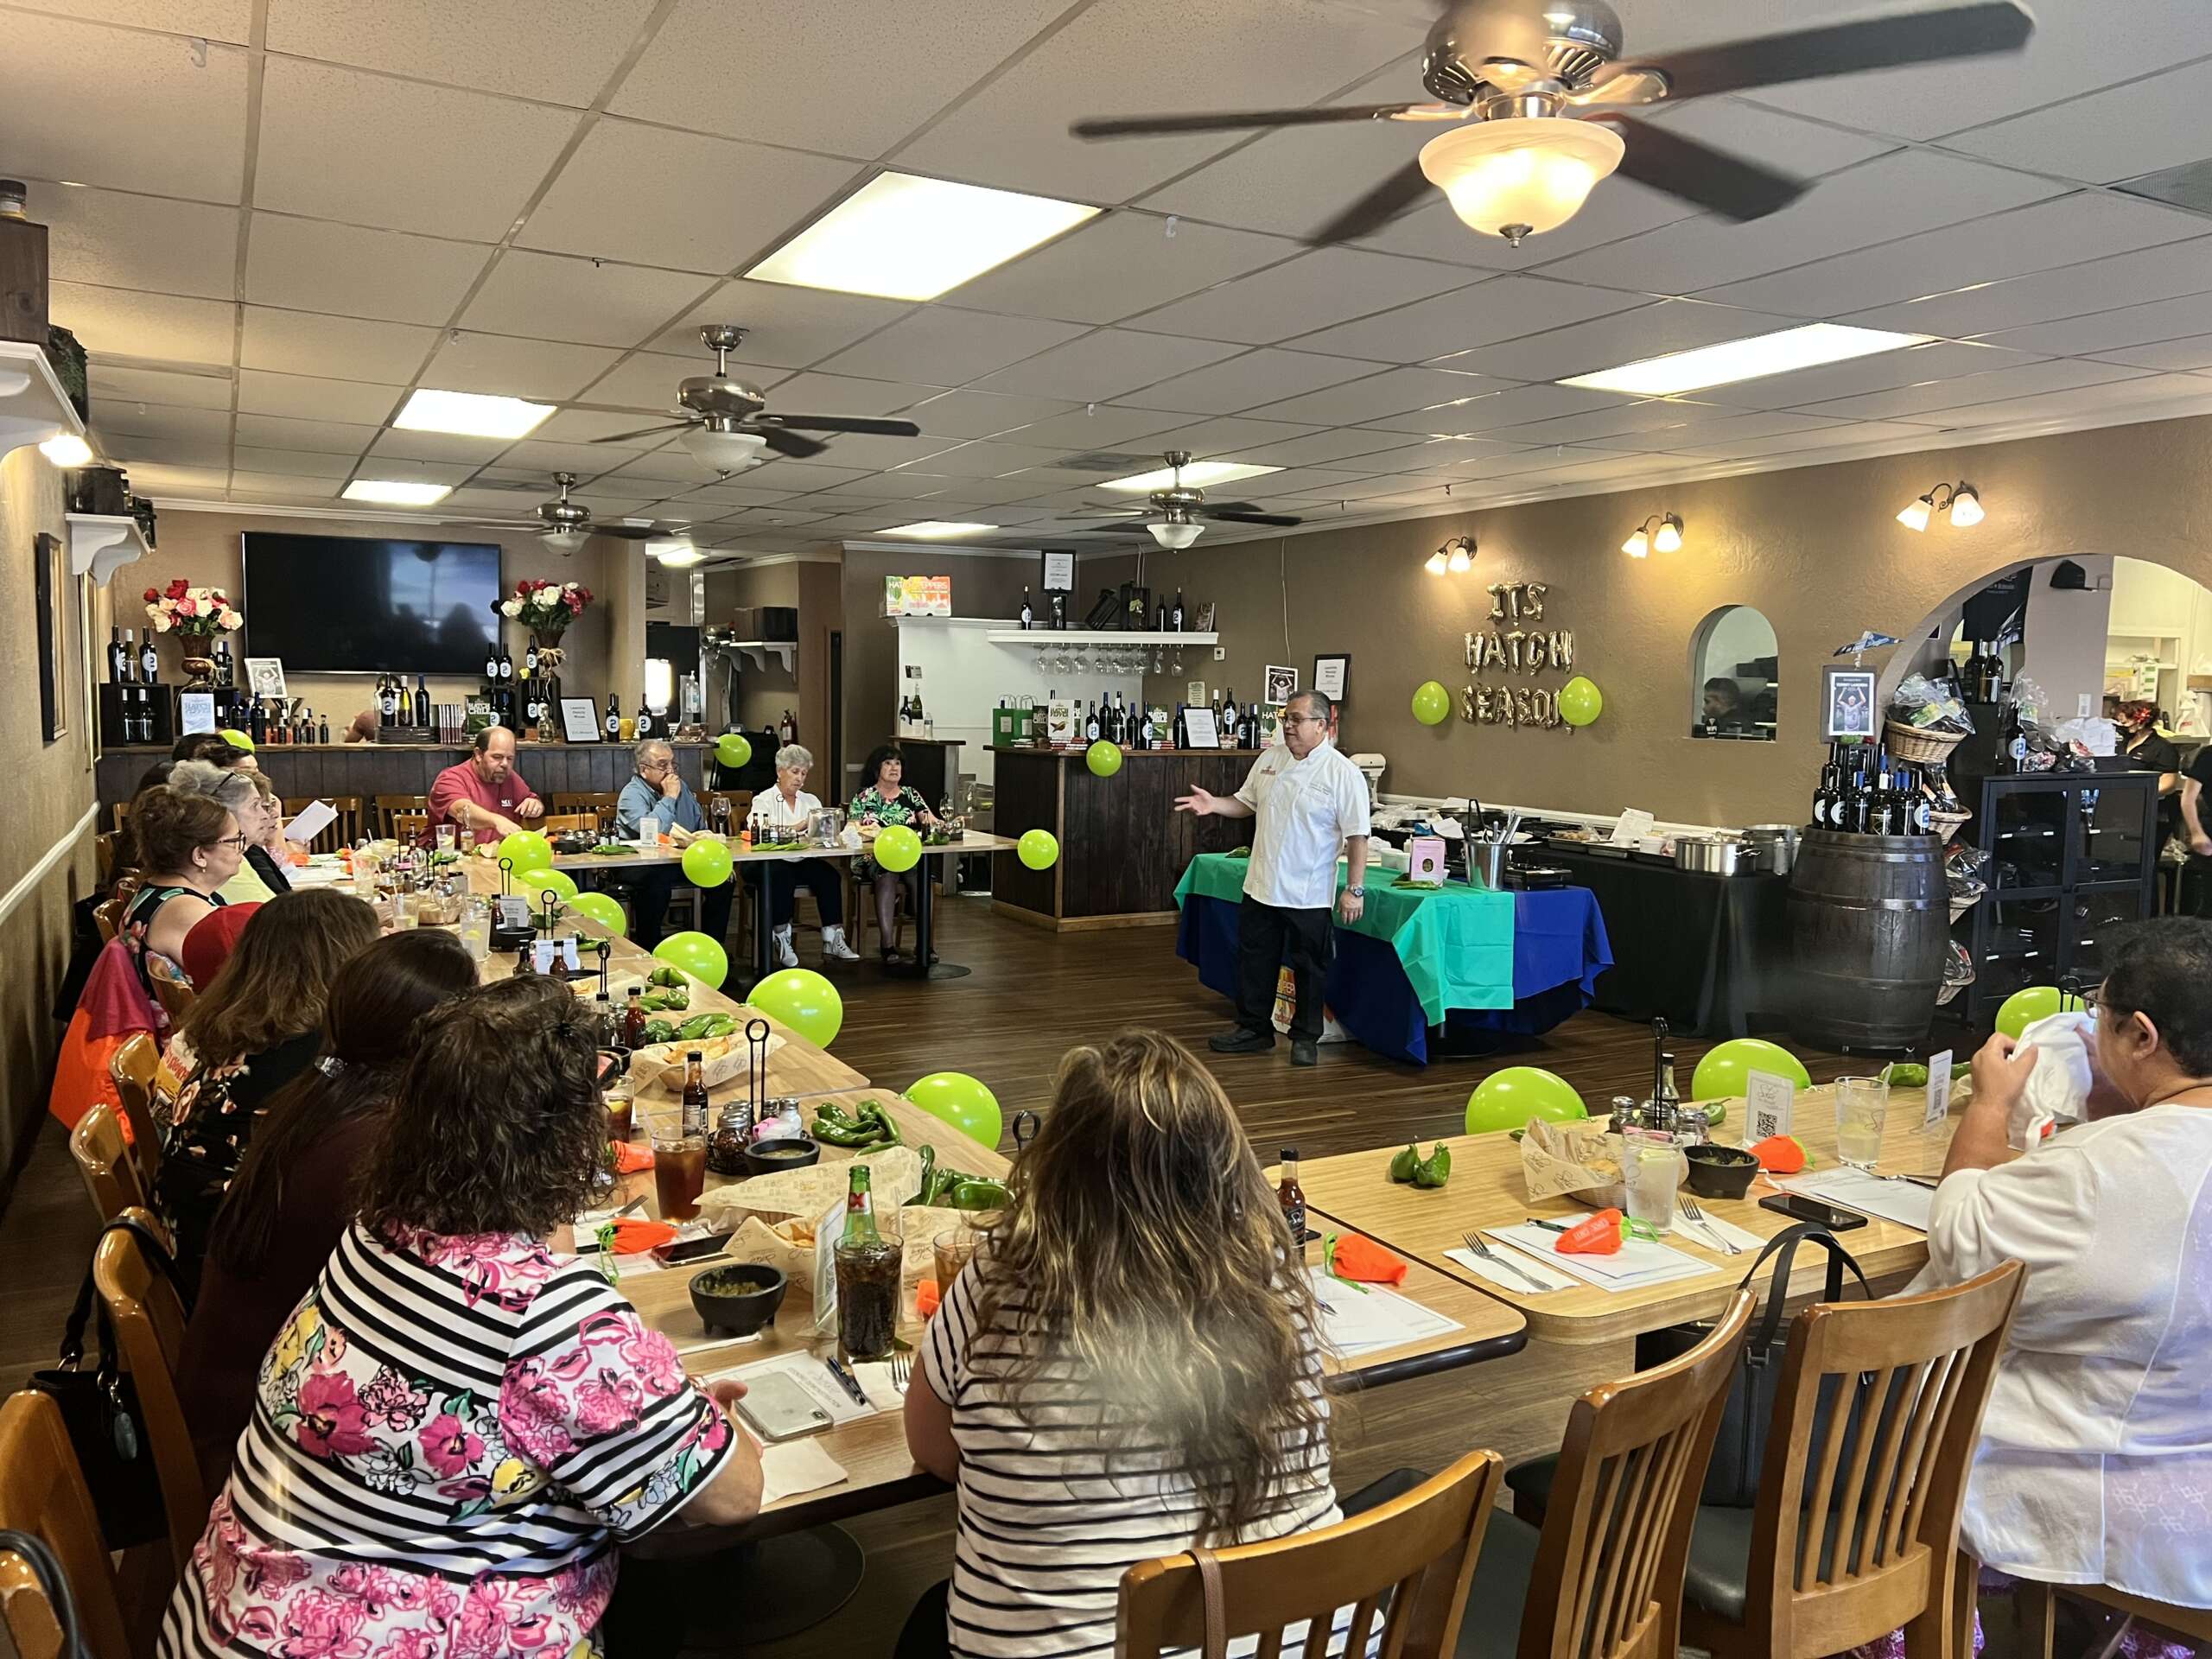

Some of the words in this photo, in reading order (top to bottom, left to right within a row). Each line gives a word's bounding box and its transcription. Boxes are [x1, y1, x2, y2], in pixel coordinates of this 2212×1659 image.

[1486, 582, 1548, 626] ITS
[1464, 629, 1574, 675] HATCH
[385, 701, 392, 711] 2
[1459, 685, 1562, 733] SEASO
[610, 719, 616, 728] 2
[640, 719, 646, 728] 2
[1090, 727, 1097, 735] 2
